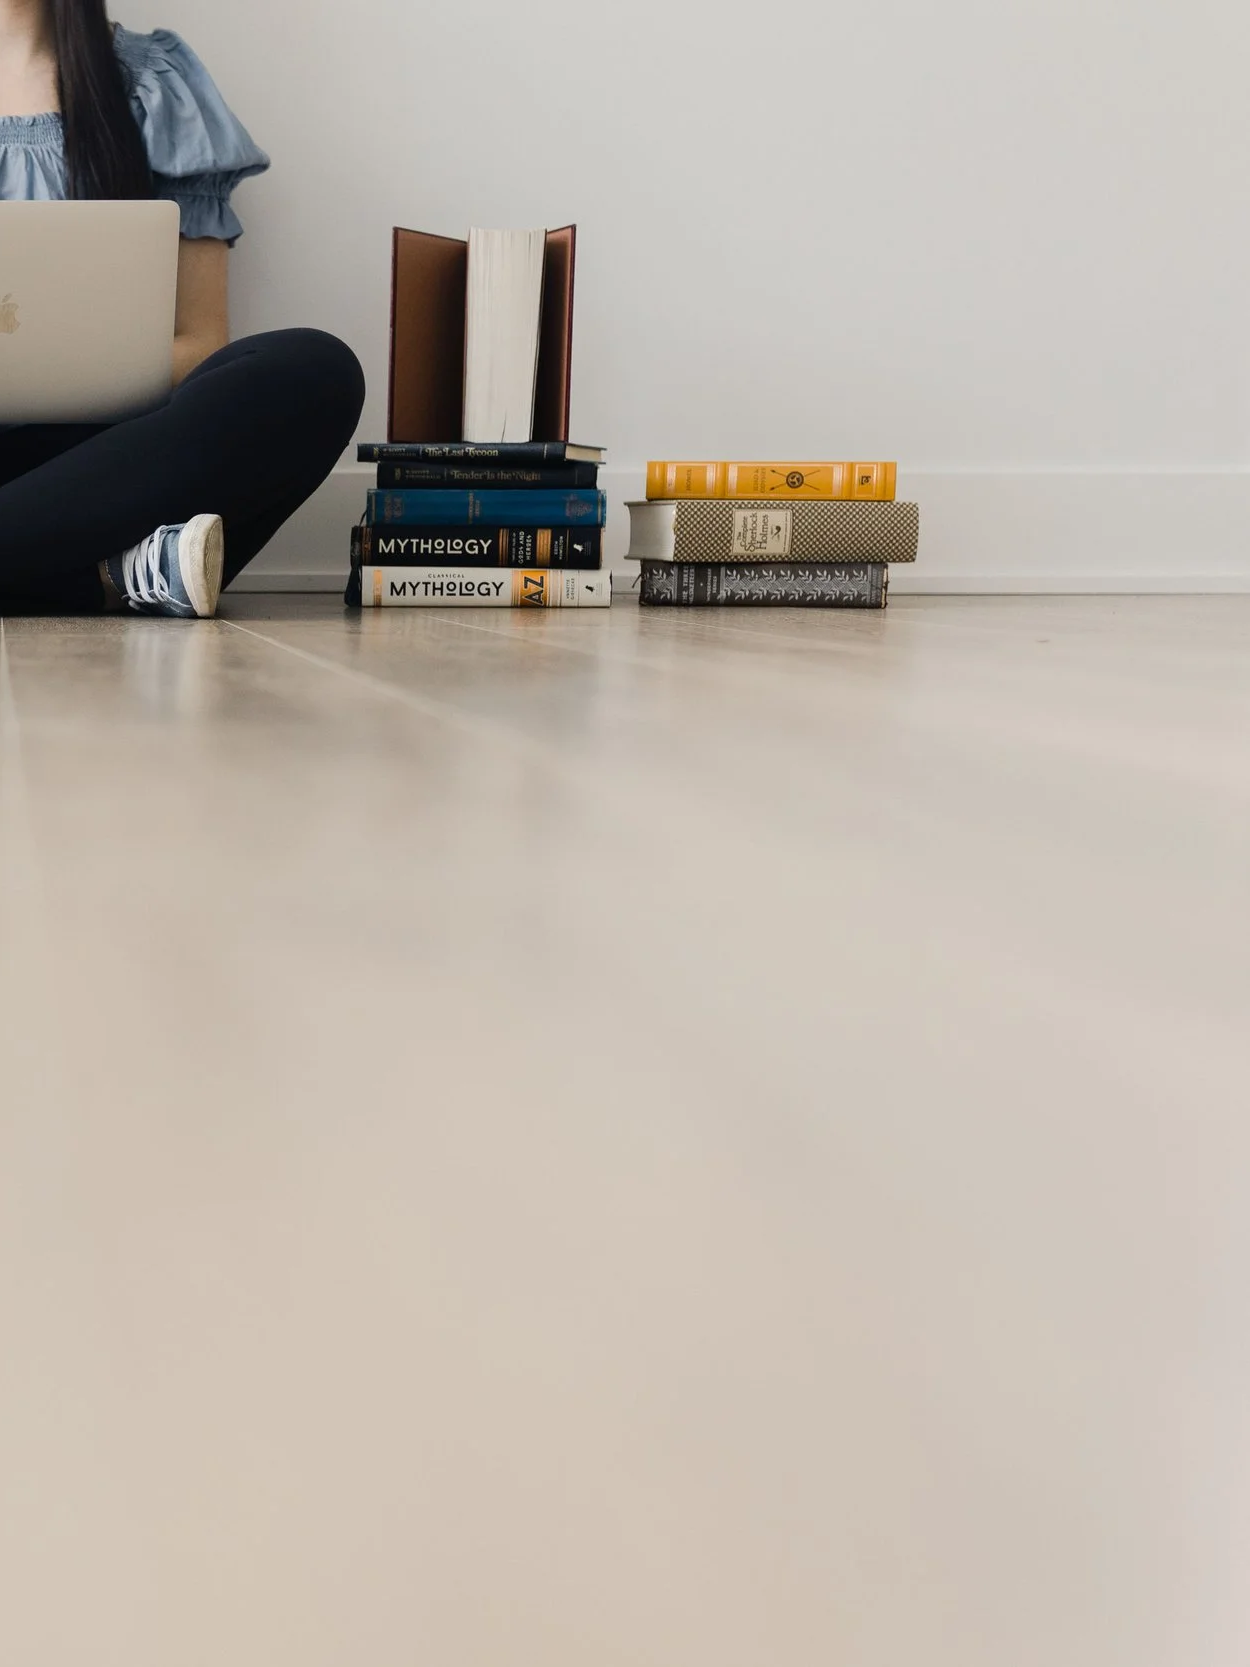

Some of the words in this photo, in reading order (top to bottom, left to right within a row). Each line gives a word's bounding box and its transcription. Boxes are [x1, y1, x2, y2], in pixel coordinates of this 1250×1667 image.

[424, 447, 442, 457] The
[443, 447, 464, 458] Last
[465, 446, 499, 458] Tycoon
[450, 470, 484, 480] Tender
[497, 470, 511, 481] the
[512, 470, 542, 482] Night
[740, 516, 748, 547] Complete
[744, 512, 757, 552] Sherlock
[756, 514, 768, 550] Holmes
[378, 538, 493, 555] MYTHOLOGY
[390, 581, 505, 597] MYTHOLOGY
